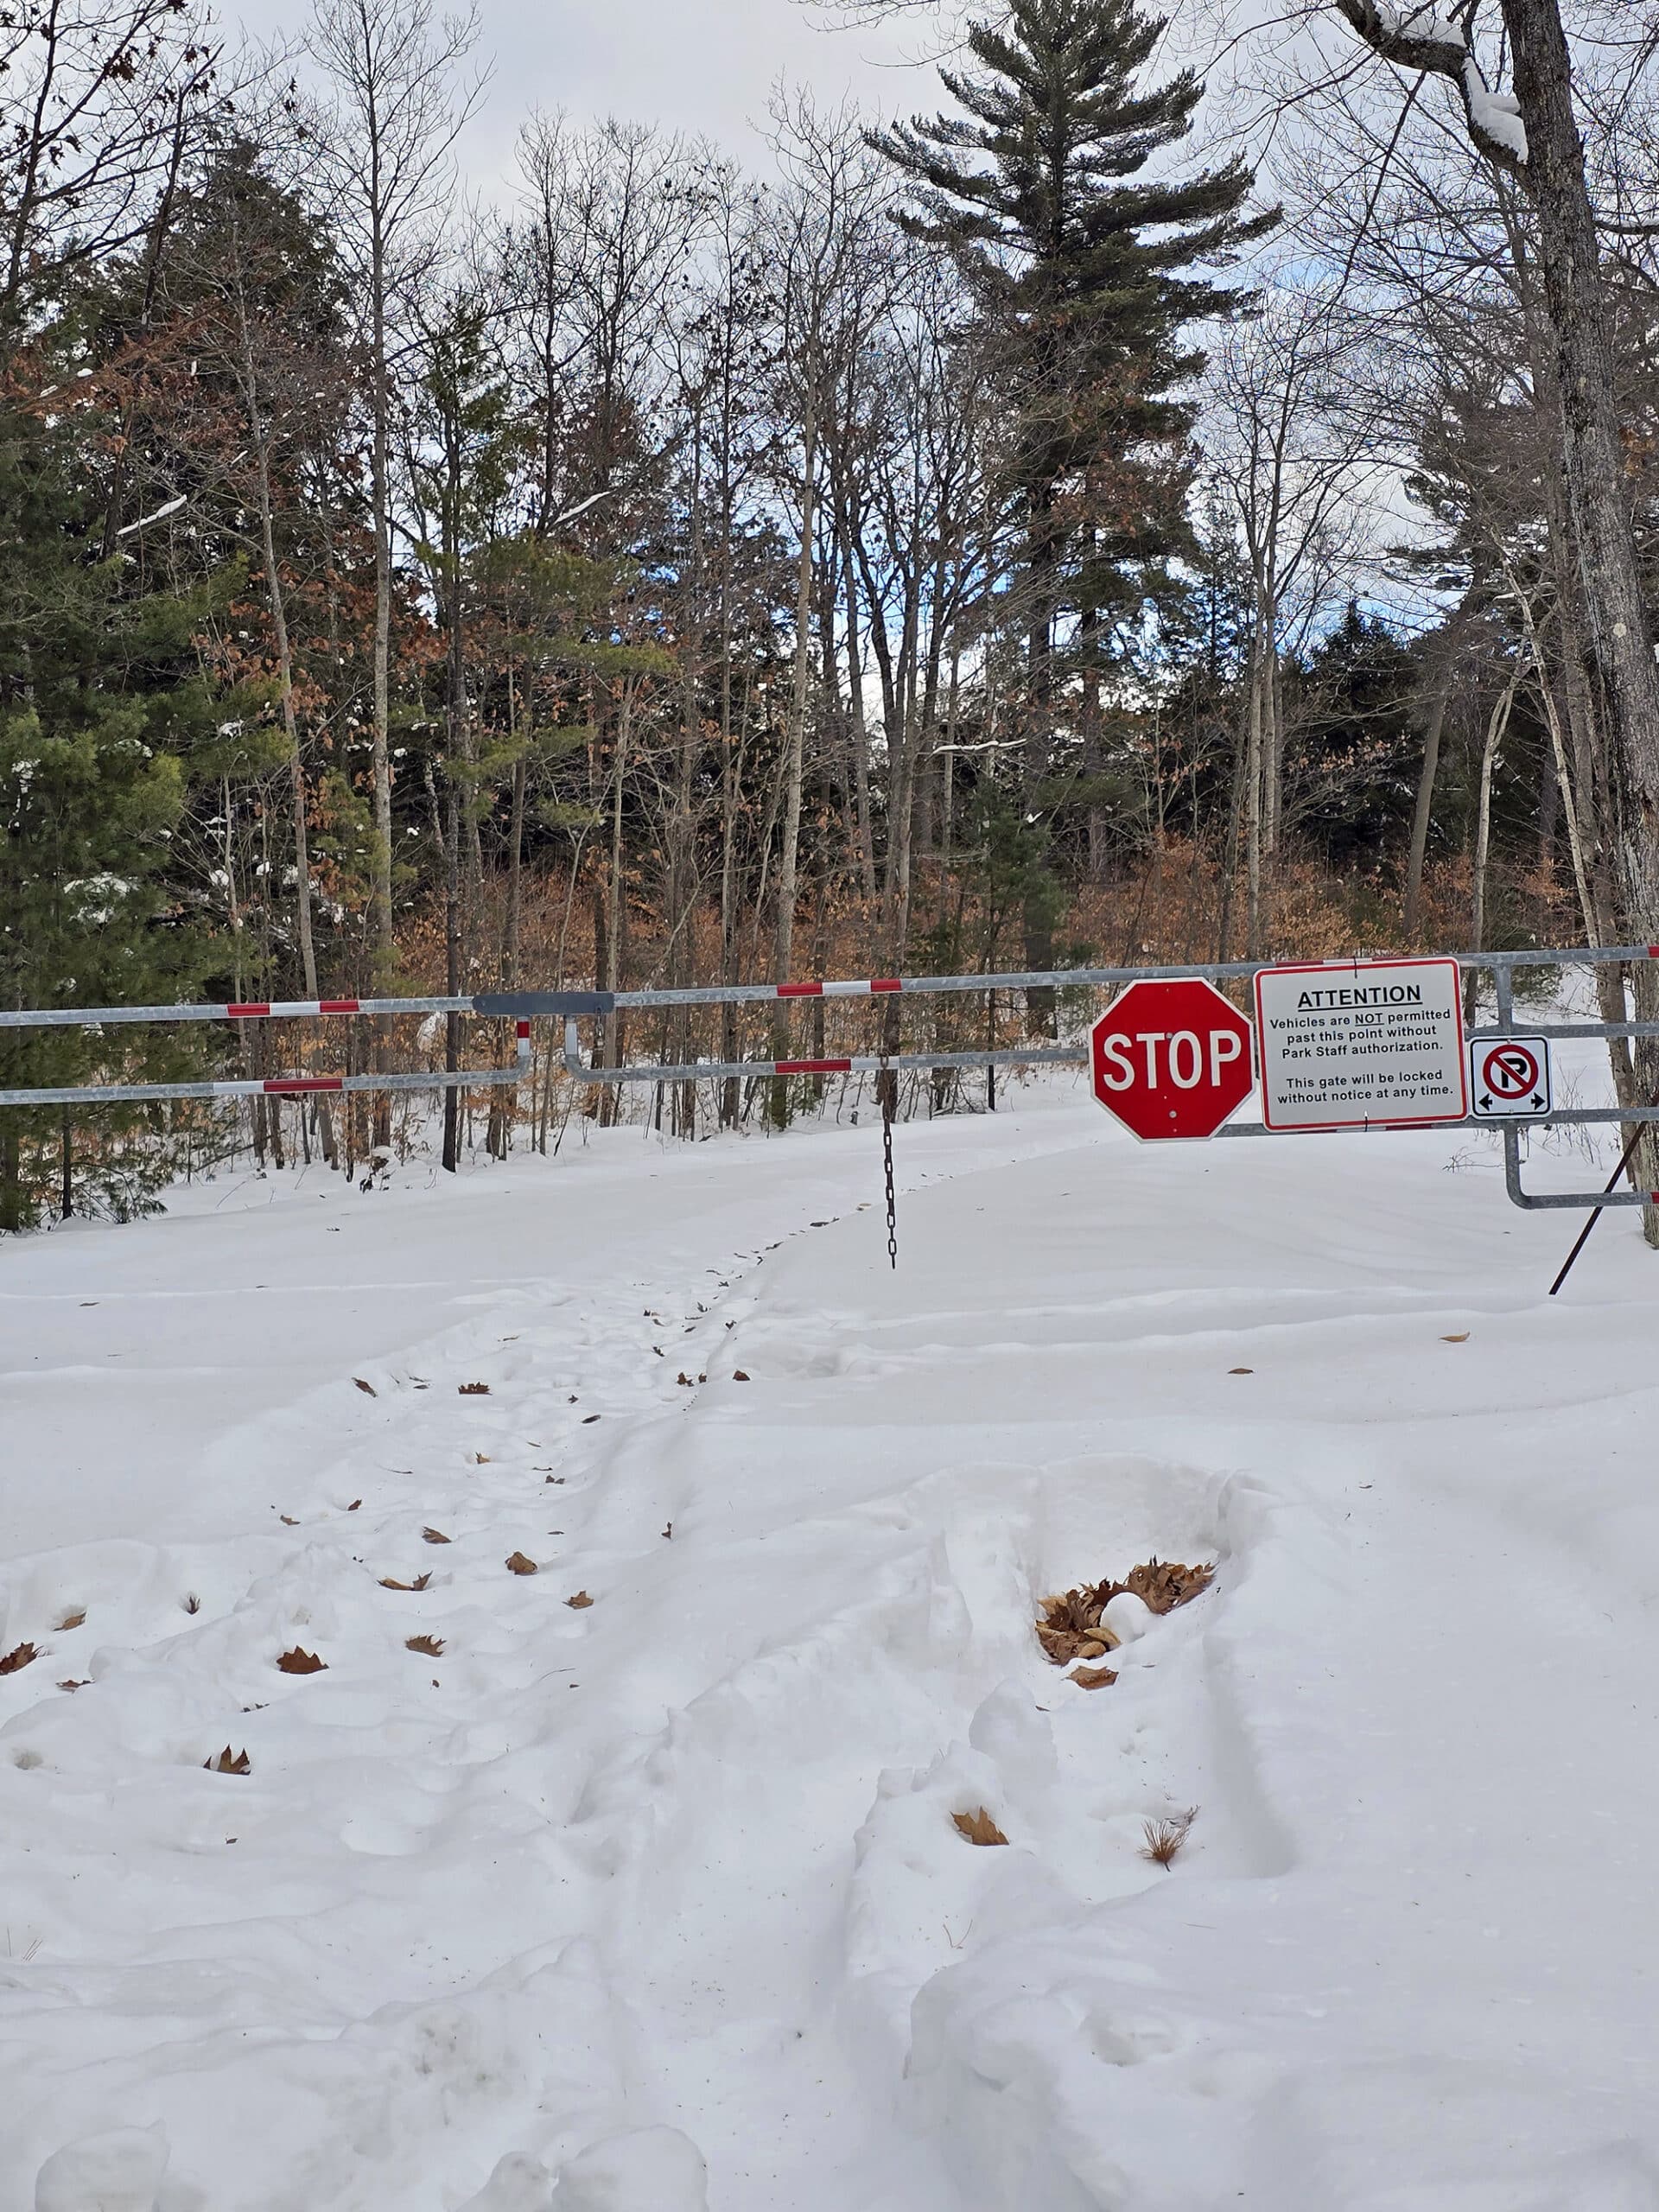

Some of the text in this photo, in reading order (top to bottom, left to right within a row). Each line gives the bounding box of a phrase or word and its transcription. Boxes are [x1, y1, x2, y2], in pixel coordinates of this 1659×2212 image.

[1296, 983, 1423, 1009] ATTENTION
[1269, 1008, 1451, 1030] Vehicles are NOT permitted
[1287, 1025, 1437, 1046] past this point without
[1281, 1039, 1444, 1059] Park Staff authorization.
[1103, 1030, 1242, 1091] STOP
[1285, 1069, 1443, 1090] This gate will be locked
[1277, 1084, 1453, 1104] without notice at any time.
